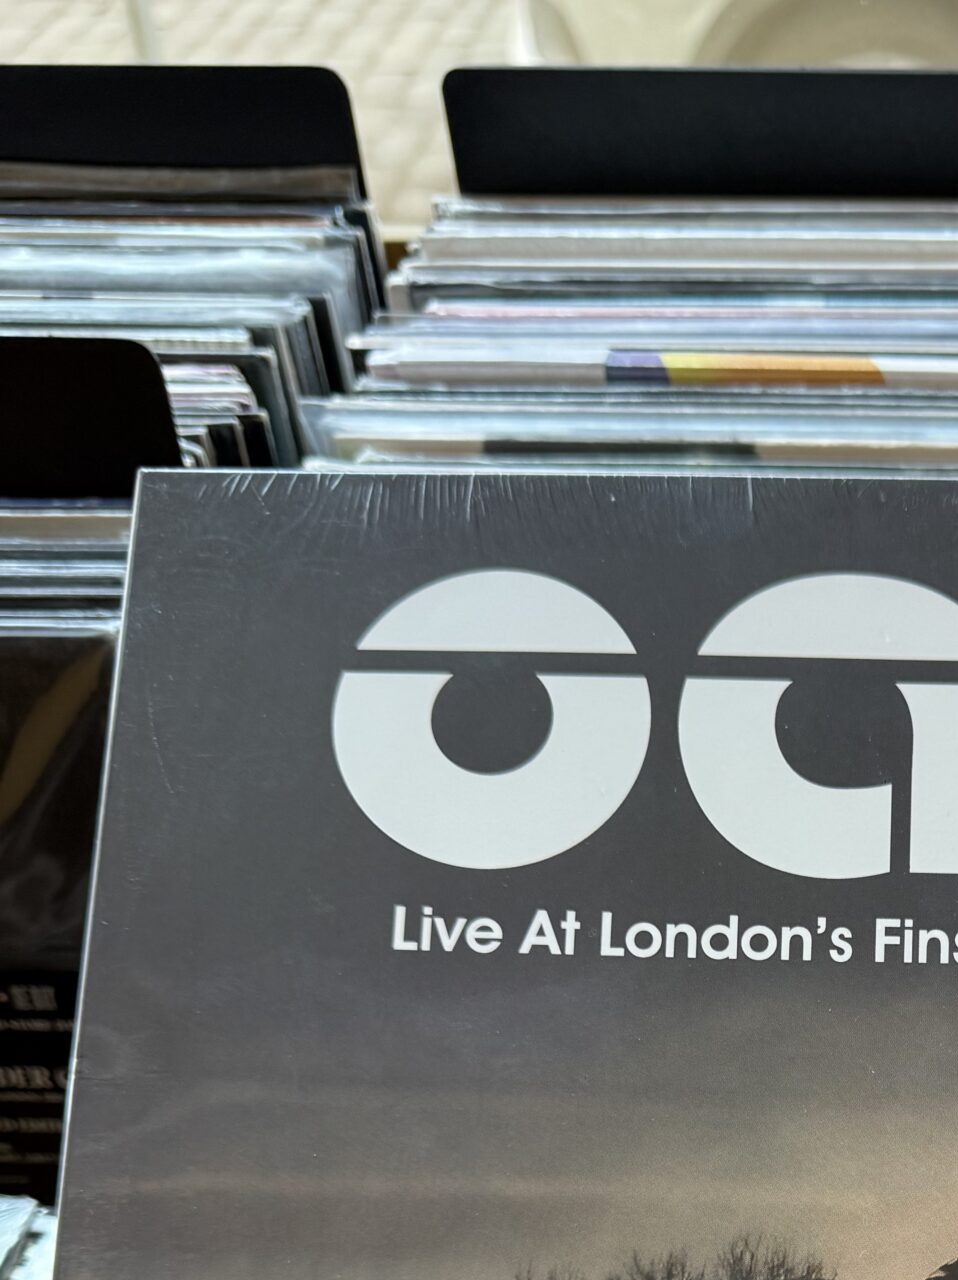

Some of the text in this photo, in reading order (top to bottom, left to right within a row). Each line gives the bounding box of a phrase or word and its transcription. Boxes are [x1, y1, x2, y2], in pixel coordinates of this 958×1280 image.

[392, 905, 503, 954] Live
[518, 909, 581, 956] At
[600, 911, 853, 963] London's
